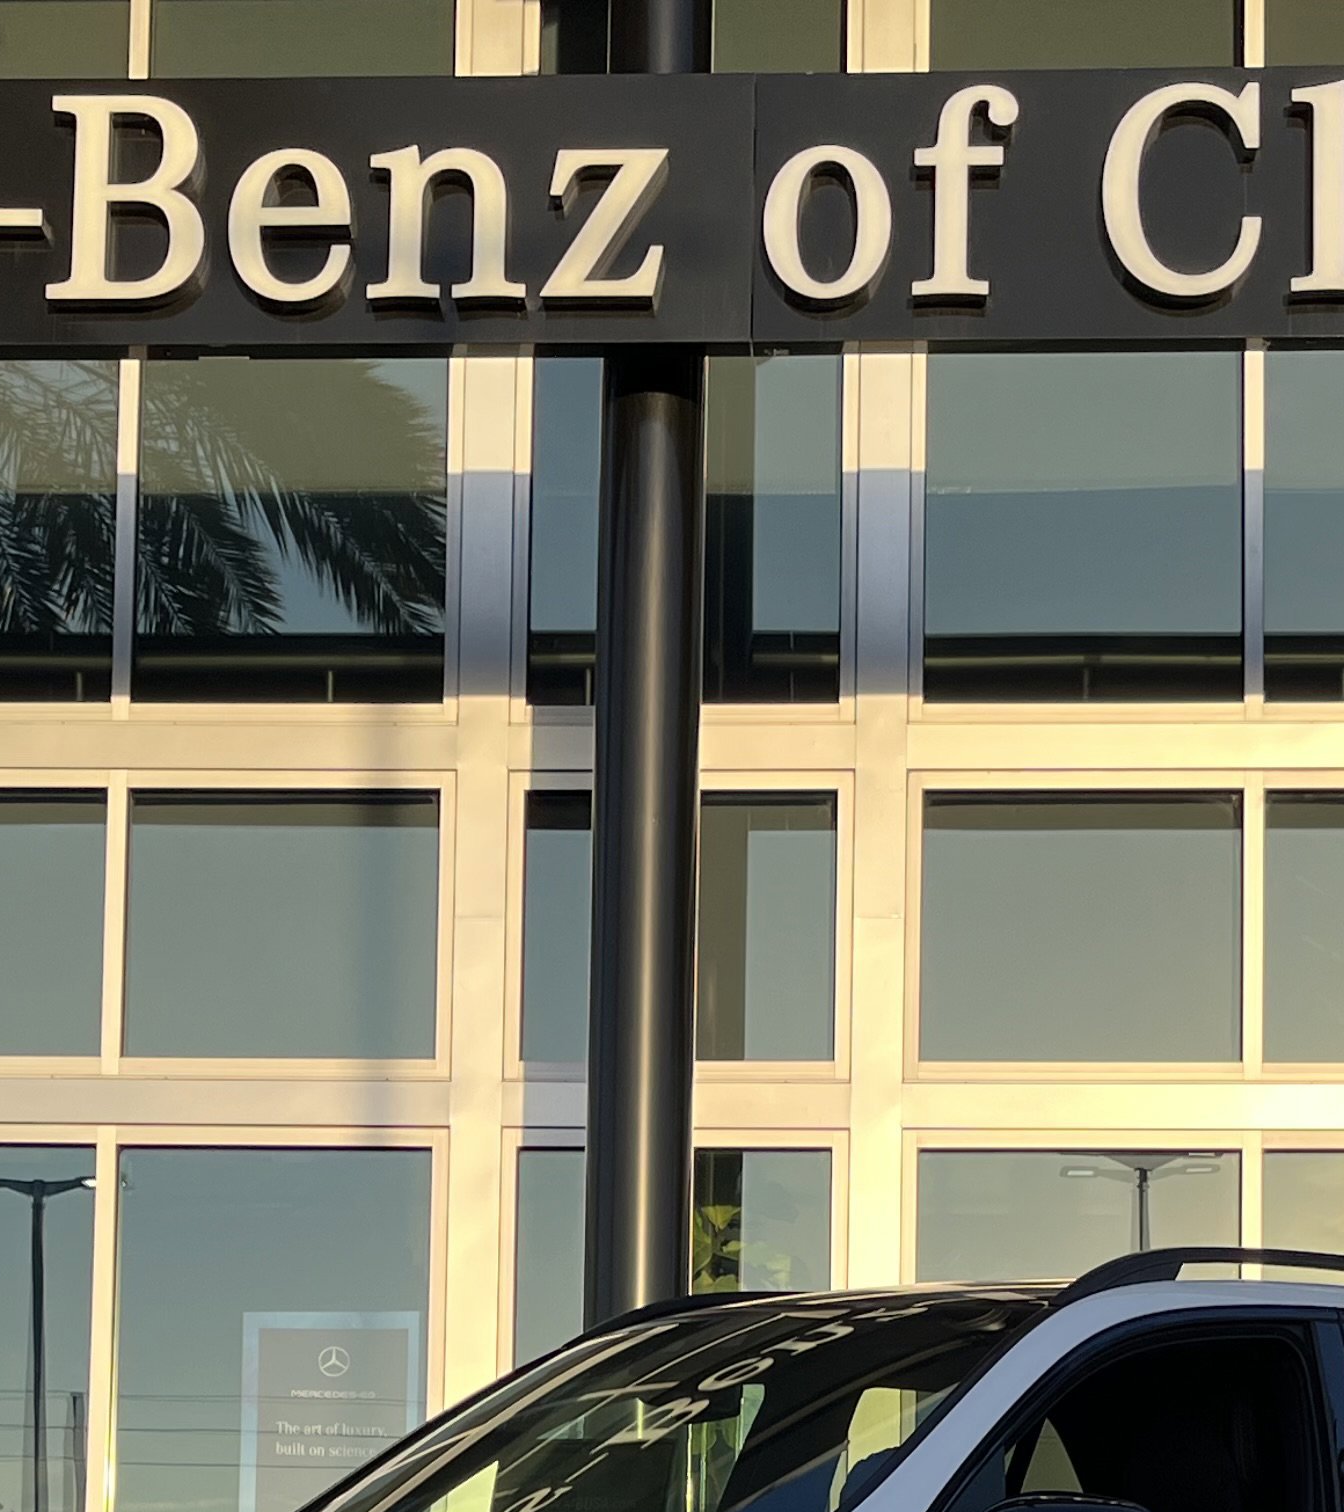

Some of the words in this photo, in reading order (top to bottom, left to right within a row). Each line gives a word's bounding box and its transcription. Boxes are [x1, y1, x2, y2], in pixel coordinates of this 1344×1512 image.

[762, 84, 1020, 299] of
[275, 1420, 300, 1435] The
[303, 1424, 322, 1436] art
[325, 1422, 340, 1436] of
[276, 1440, 305, 1456] built
[308, 1446, 325, 1457] on
